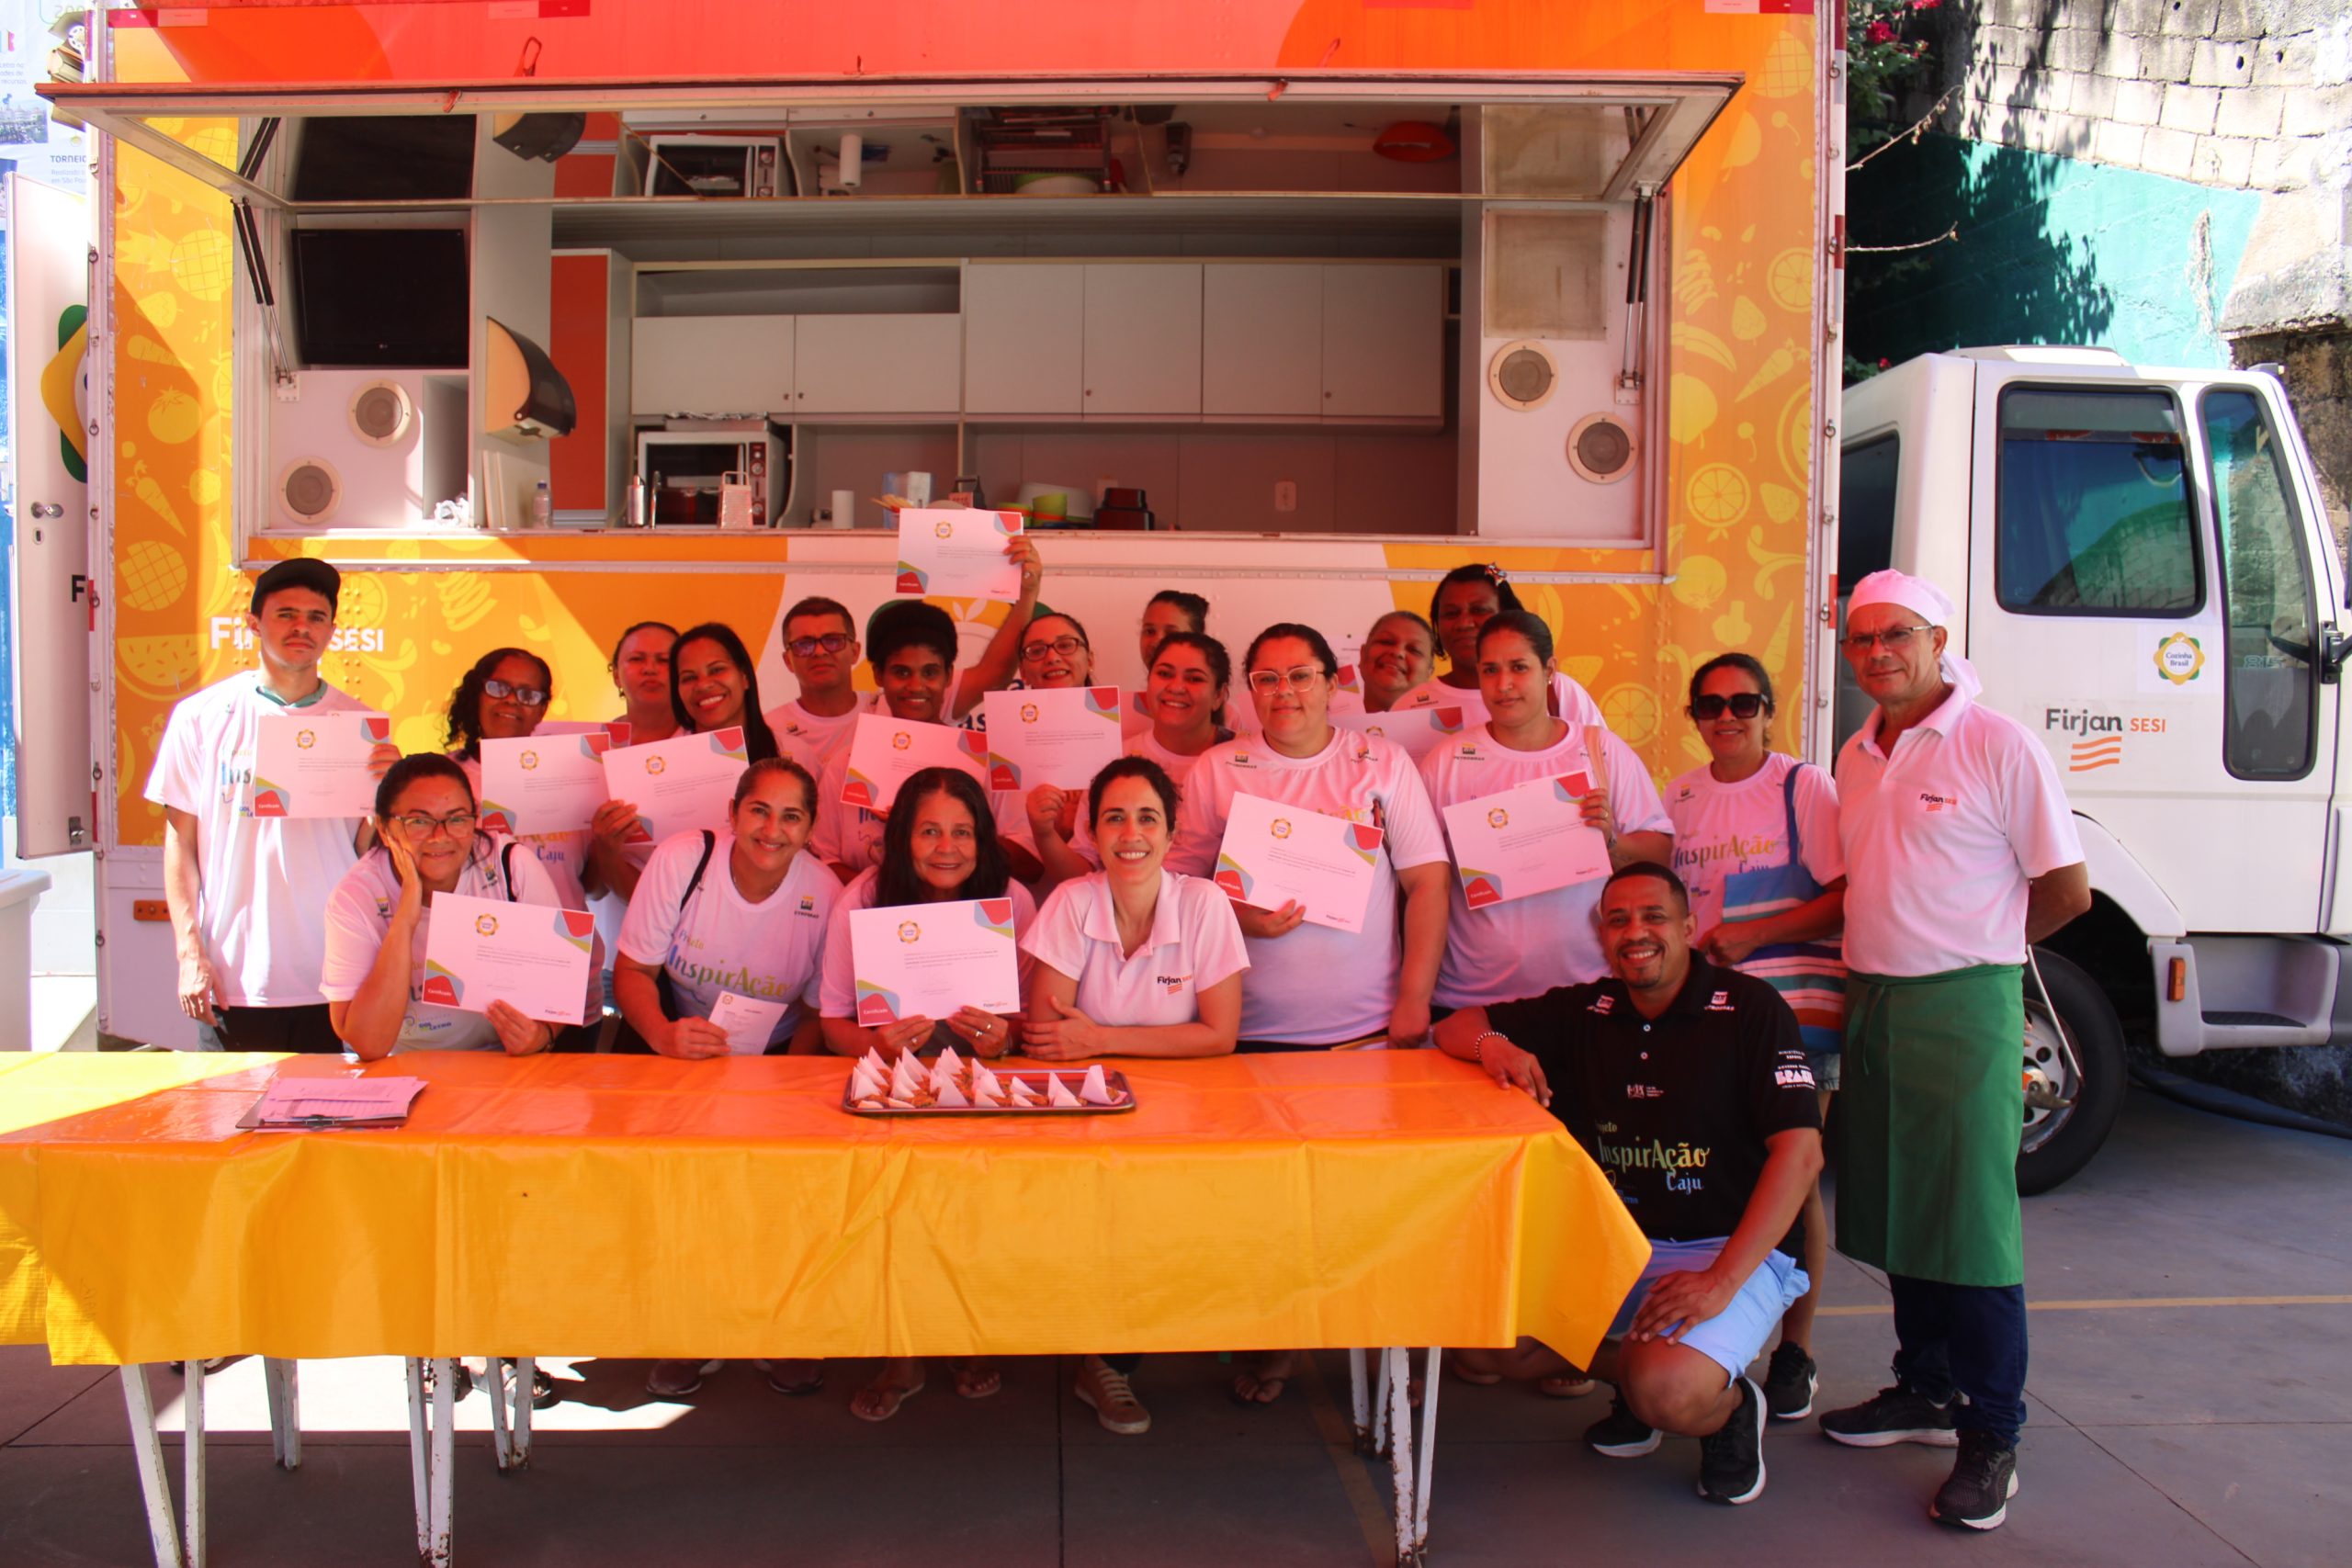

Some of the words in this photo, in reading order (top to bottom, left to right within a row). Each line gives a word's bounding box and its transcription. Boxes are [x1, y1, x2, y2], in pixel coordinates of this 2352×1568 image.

[328, 627, 384, 652] SESI
[2165, 651, 2193, 660] Cozinha
[2045, 708, 2123, 737] Firjan
[2130, 717, 2166, 733] SESI
[537, 846, 564, 863] Caju
[668, 944, 791, 998] InspirAção
[1597, 1135, 1711, 1178] InspirAção
[1666, 1170, 1704, 1196] Caju
